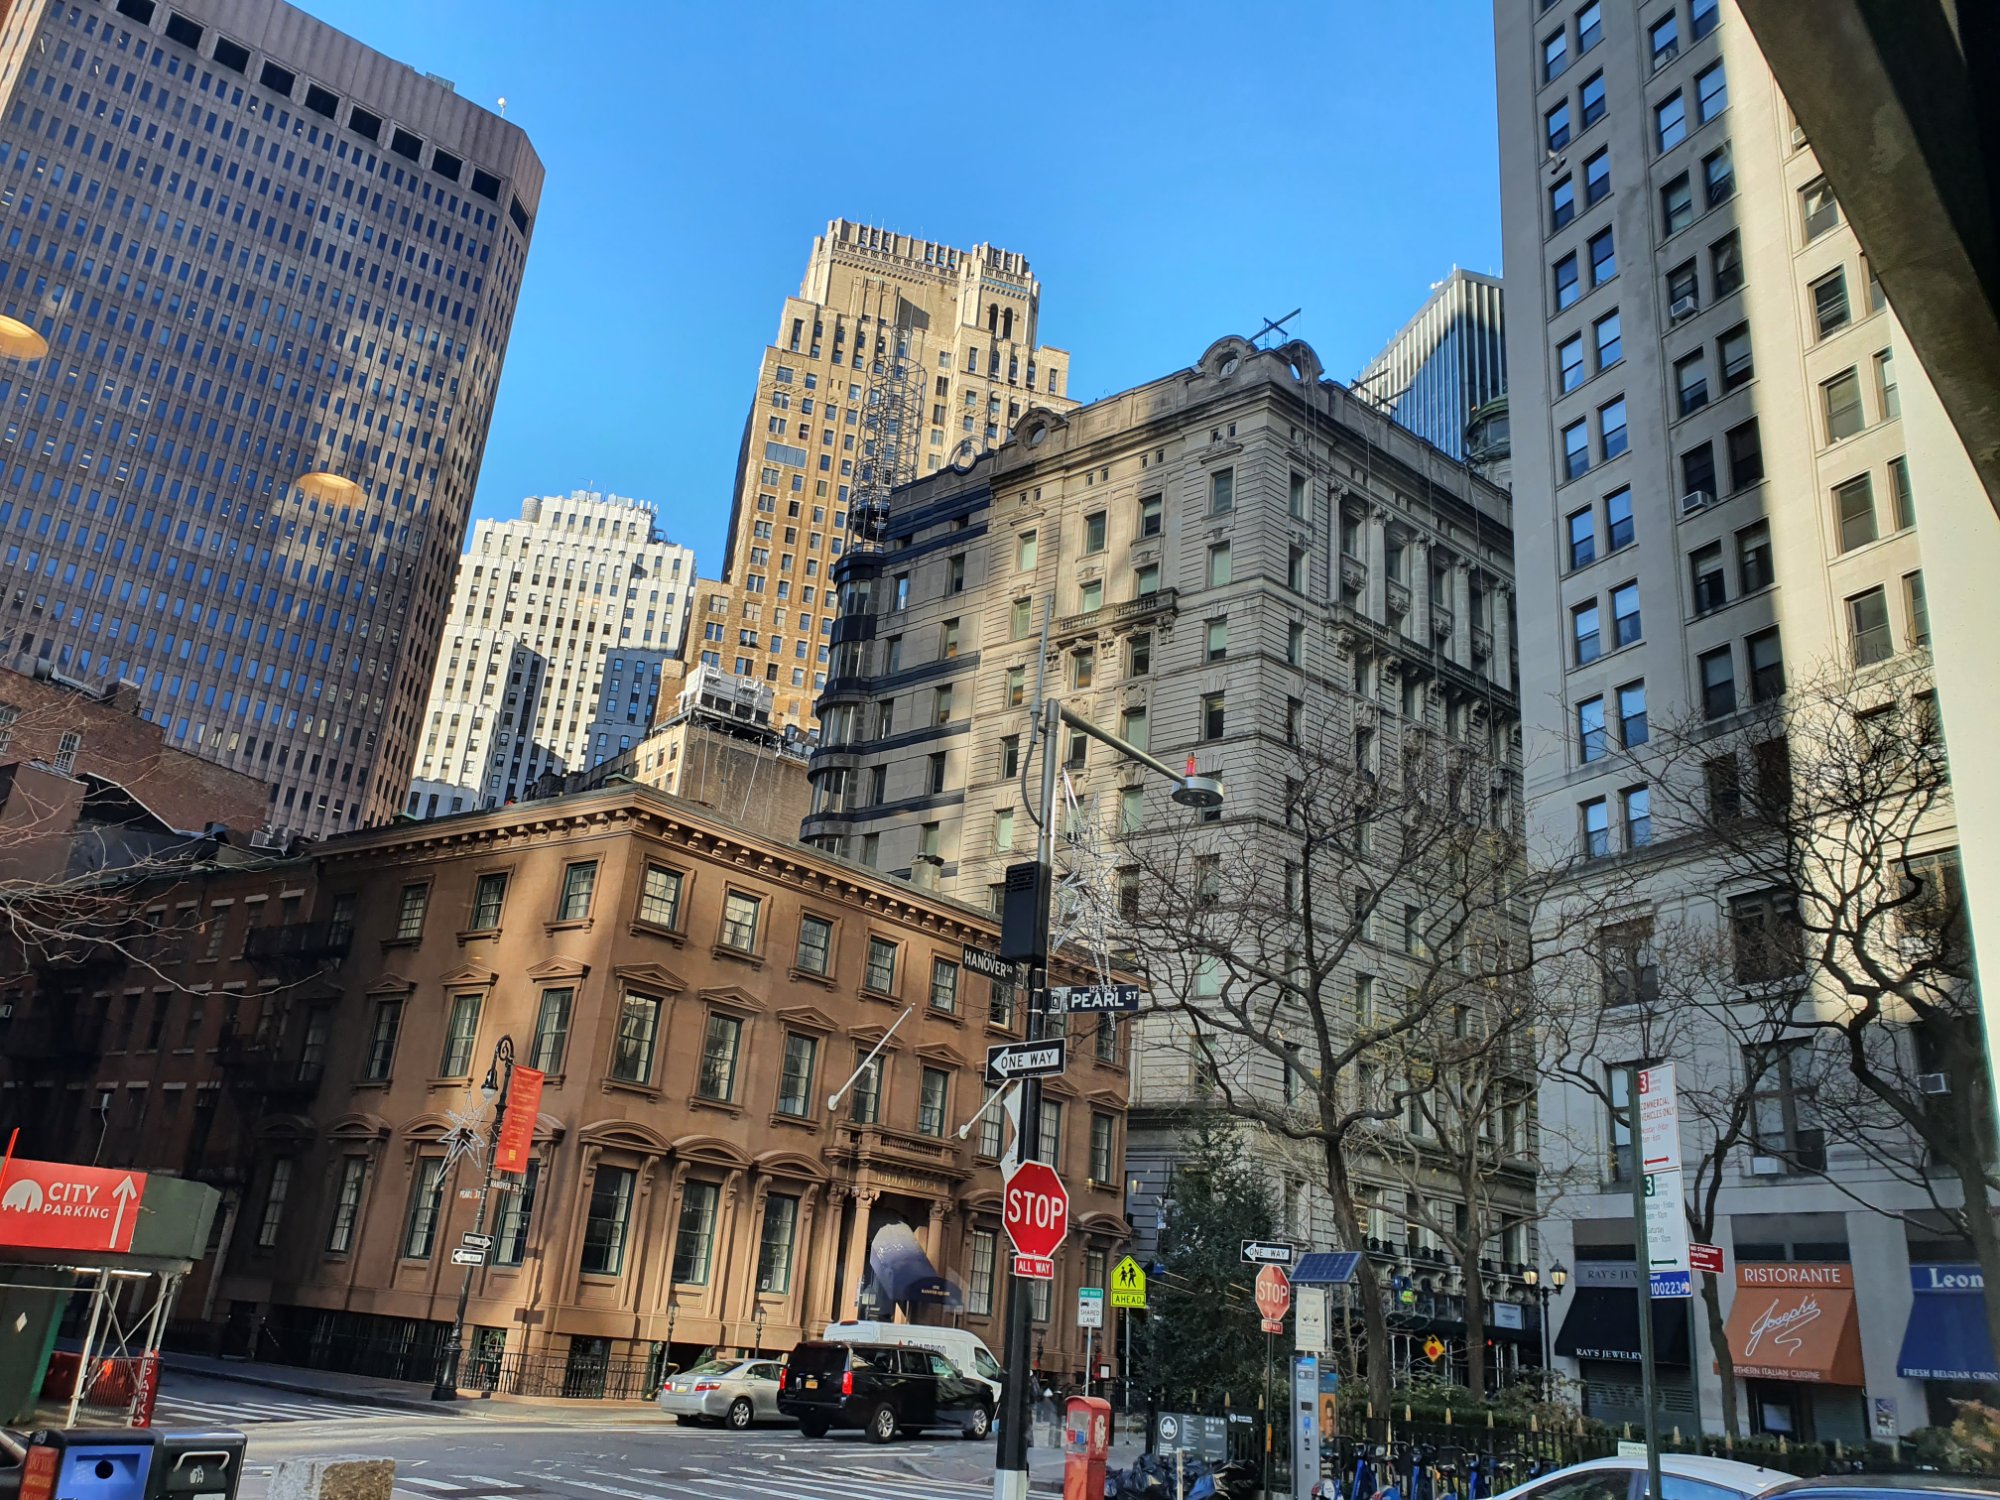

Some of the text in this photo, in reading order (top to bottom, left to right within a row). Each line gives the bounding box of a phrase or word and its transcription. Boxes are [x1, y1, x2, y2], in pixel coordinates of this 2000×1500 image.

[964, 950, 1006, 977] HANOVER
[1071, 991, 1138, 1008] PEARL ST
[1001, 1051, 1053, 1069] ONE WAY
[1640, 1074, 1647, 1092] 3
[48, 1182, 99, 1204] CITY
[1645, 1175, 1653, 1195] 3
[43, 1203, 110, 1219] PARKING
[1008, 1188, 1064, 1230] STOP
[1249, 1247, 1287, 1258] ONE WAY
[1018, 1261, 1051, 1274] ALL WAY
[1744, 1268, 1841, 1283] RISTORANTE
[1258, 1281, 1288, 1305] STOP
[1650, 1281, 1680, 1295] 100223
[1115, 1294, 1142, 1305] AHEAD
[1576, 1348, 1642, 1360] RAY'S JEWELRY
[1762, 1367, 1788, 1377] ITALIAN
[1791, 1369, 1820, 1380] CUISINE
[1903, 1368, 1930, 1378] FRESH
